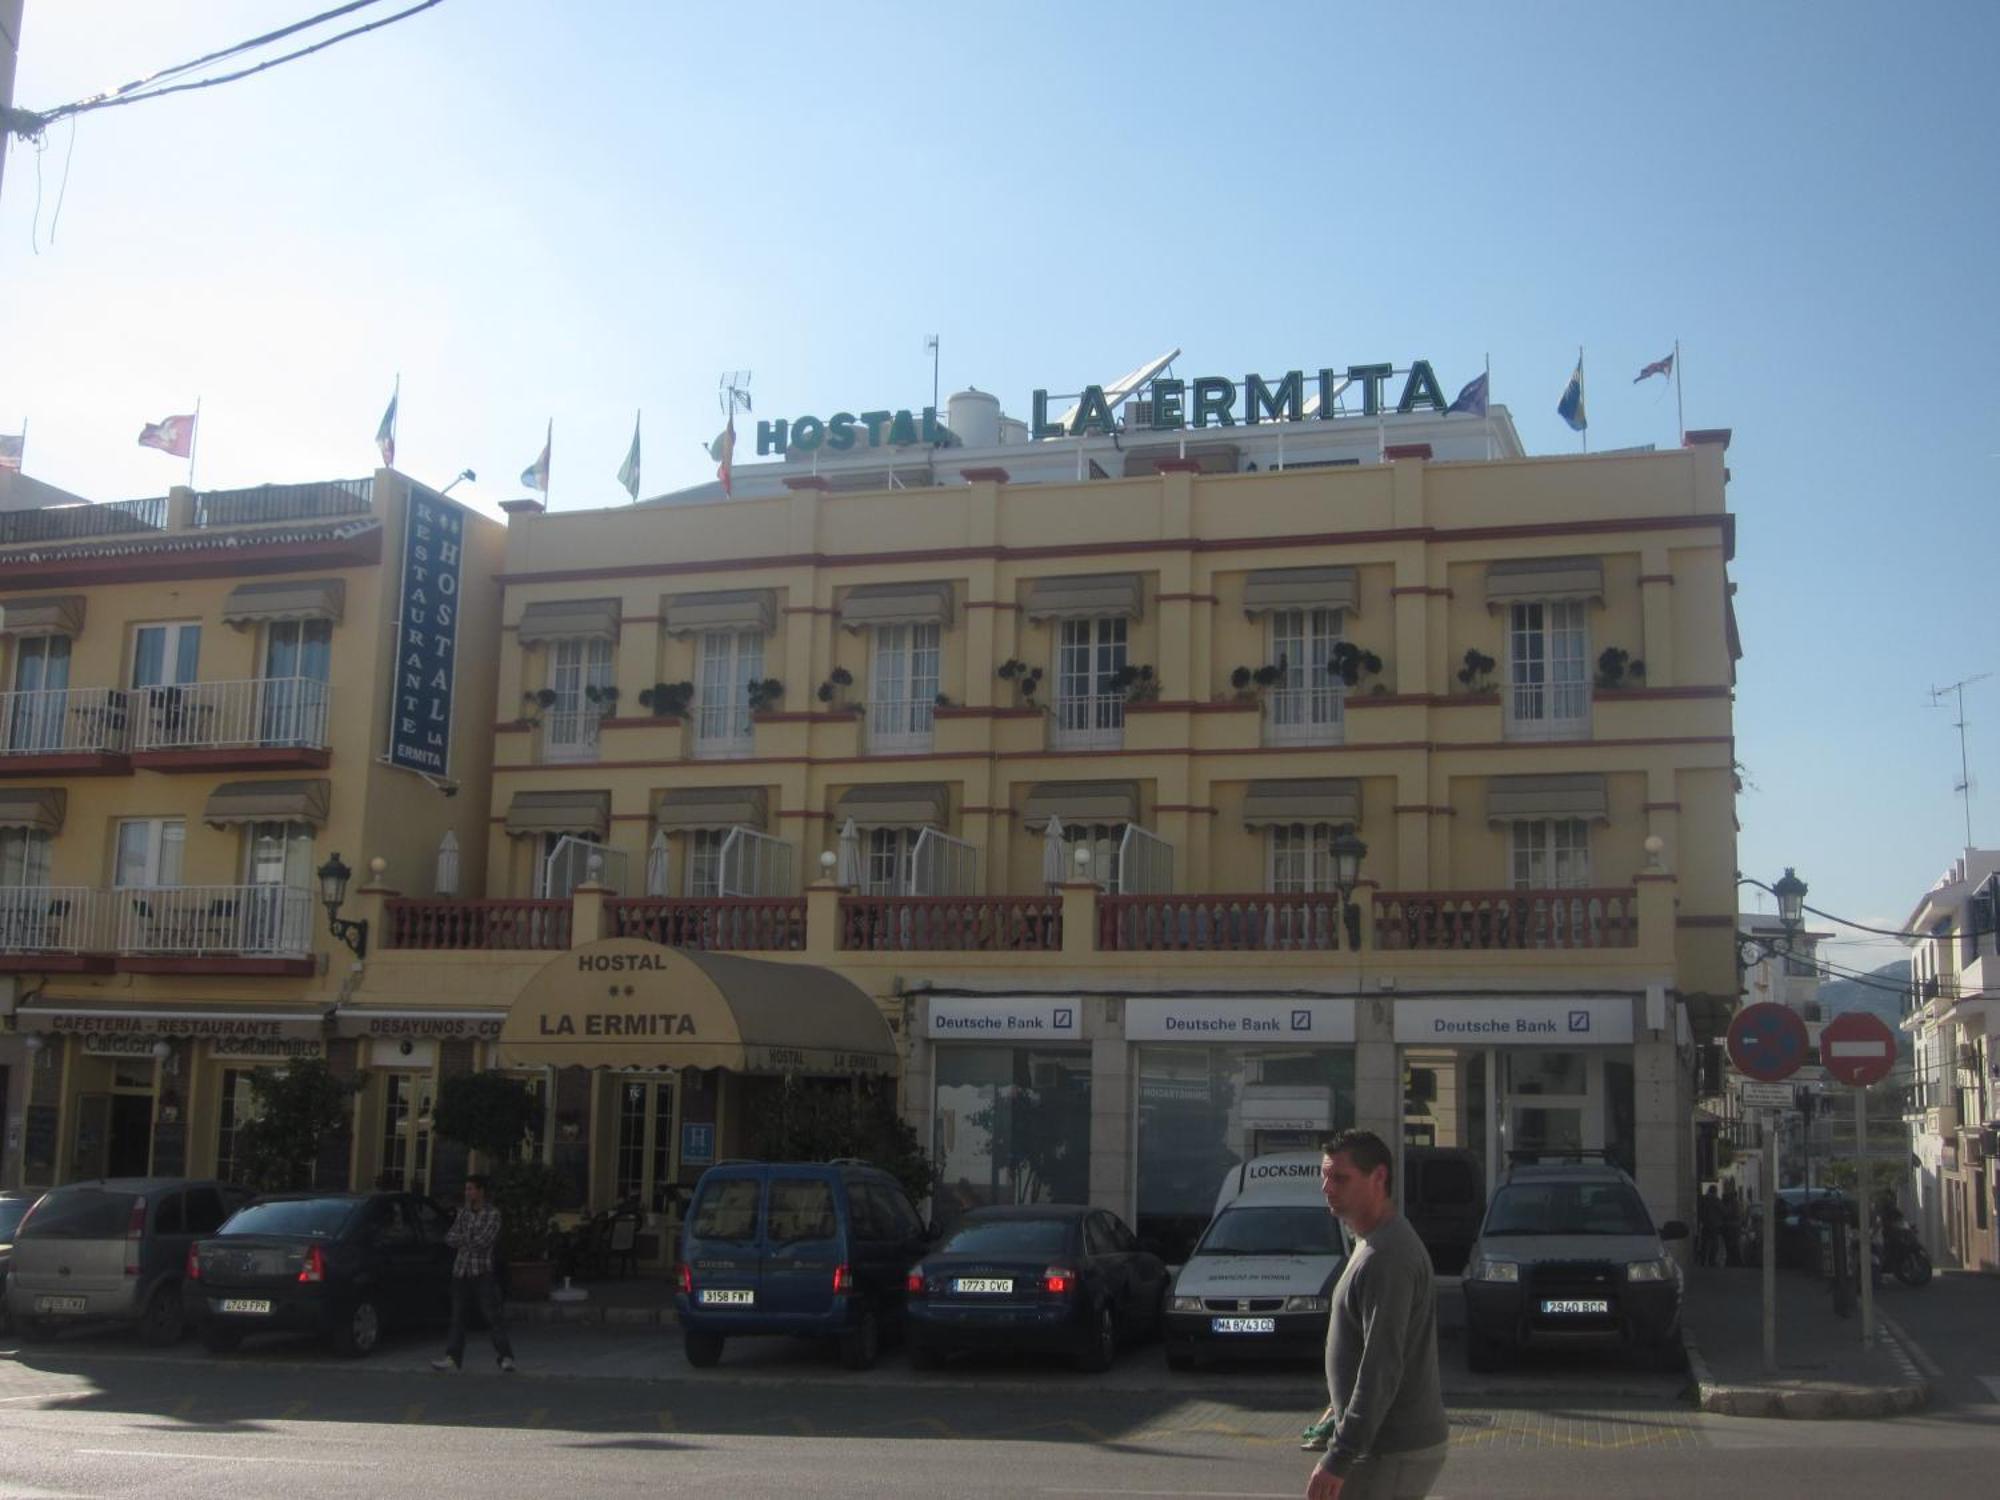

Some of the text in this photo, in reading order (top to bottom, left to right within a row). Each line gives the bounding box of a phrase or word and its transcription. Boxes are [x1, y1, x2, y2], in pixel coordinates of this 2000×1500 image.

[1032, 359, 1448, 439] LA ERMITA
[757, 406, 947, 456] HOSTAL
[402, 503, 432, 734] RESTAURANTE
[429, 541, 458, 722] HOSTAL
[428, 731, 443, 746] LA
[397, 744, 441, 767] ERMITA
[578, 955, 667, 971] HOSTAL
[52, 1014, 143, 1033] CAFETERIA
[158, 1019, 283, 1035] RESTAURANTE
[370, 1019, 466, 1034] DESAYUNOS
[540, 1014, 697, 1036] LA ERMITA
[935, 1016, 1044, 1030] Deutsche Bank
[1166, 1016, 1280, 1031] Deutsche Bank
[1434, 1018, 1557, 1033] Deutsche Bank
[706, 1291, 728, 1302] 3158
